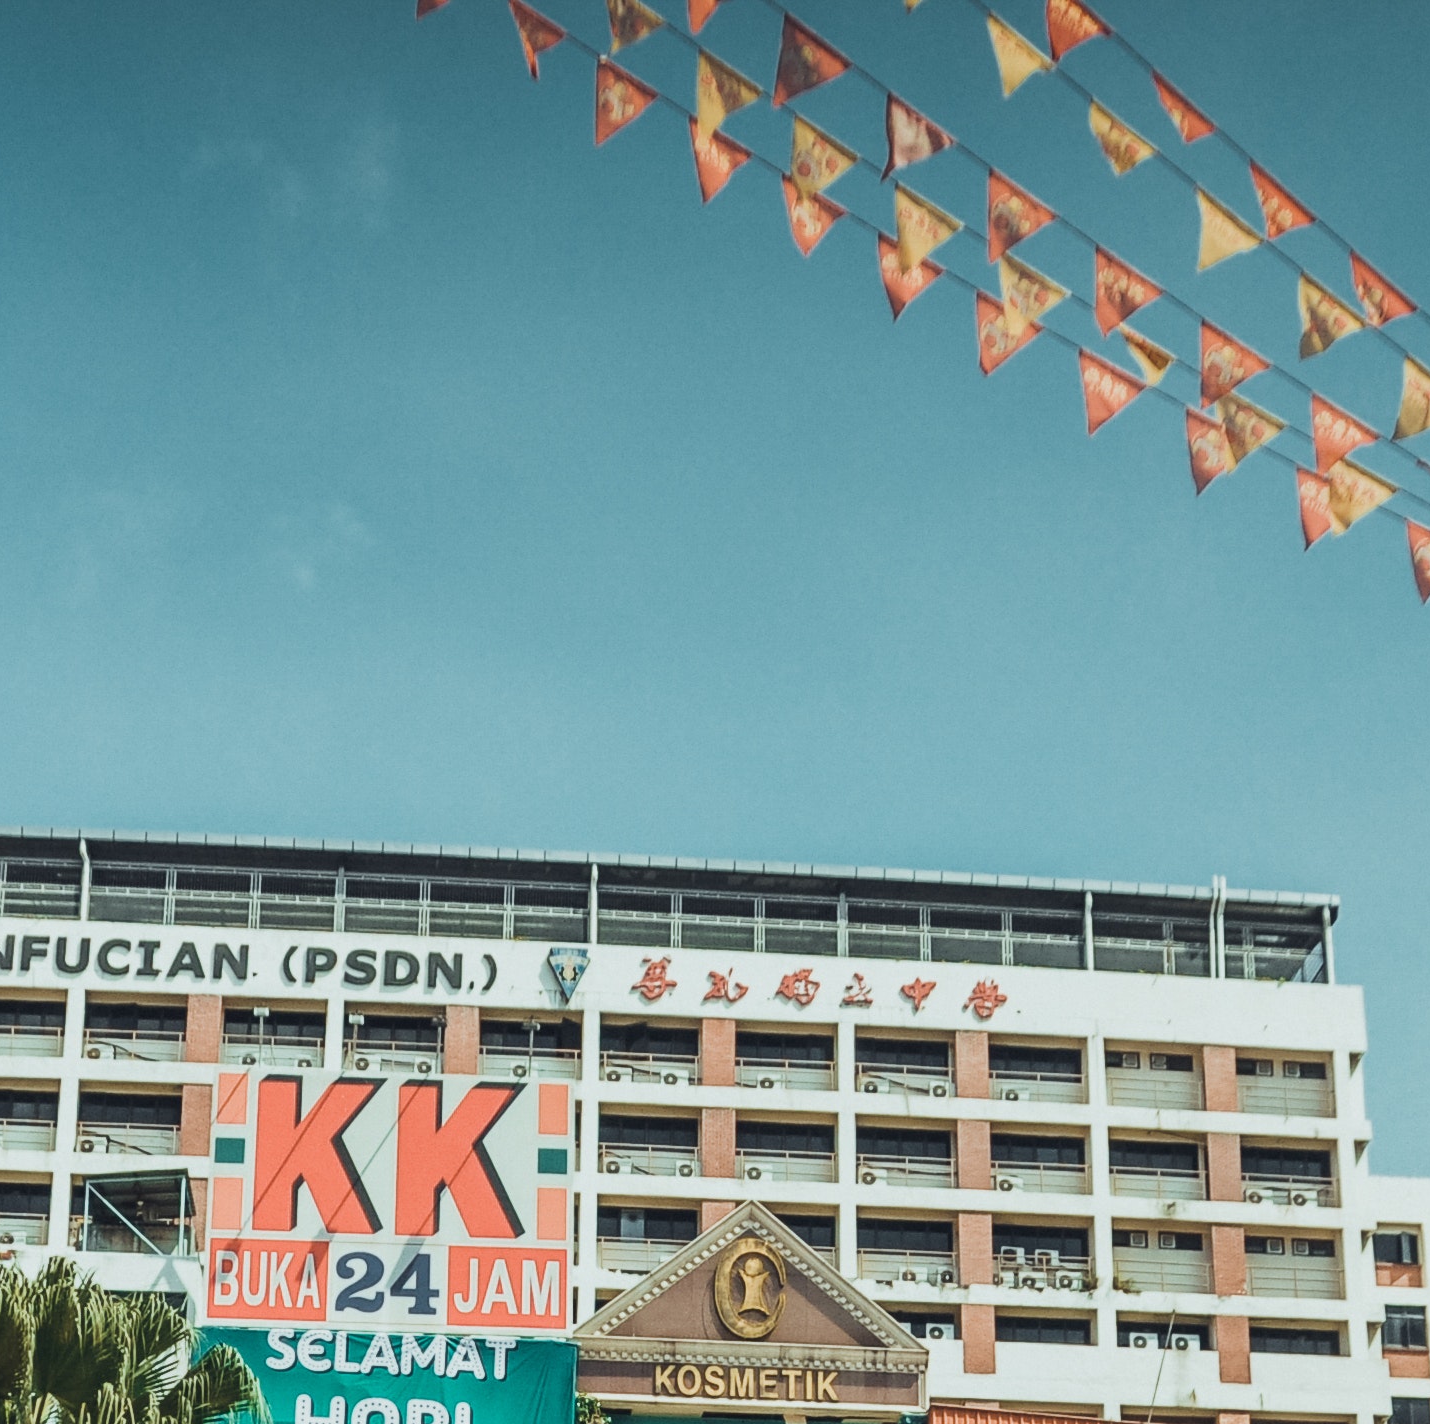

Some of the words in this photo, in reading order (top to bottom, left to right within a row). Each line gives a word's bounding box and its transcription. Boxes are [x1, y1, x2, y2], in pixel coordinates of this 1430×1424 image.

[252, 1075, 527, 1238] KK
[213, 1248, 321, 1310] BUKA
[335, 1251, 439, 1315] 24
[453, 1258, 561, 1317] JAM
[266, 1329, 517, 1380] SELAMAT
[655, 1364, 839, 1402] KOSMETIK
